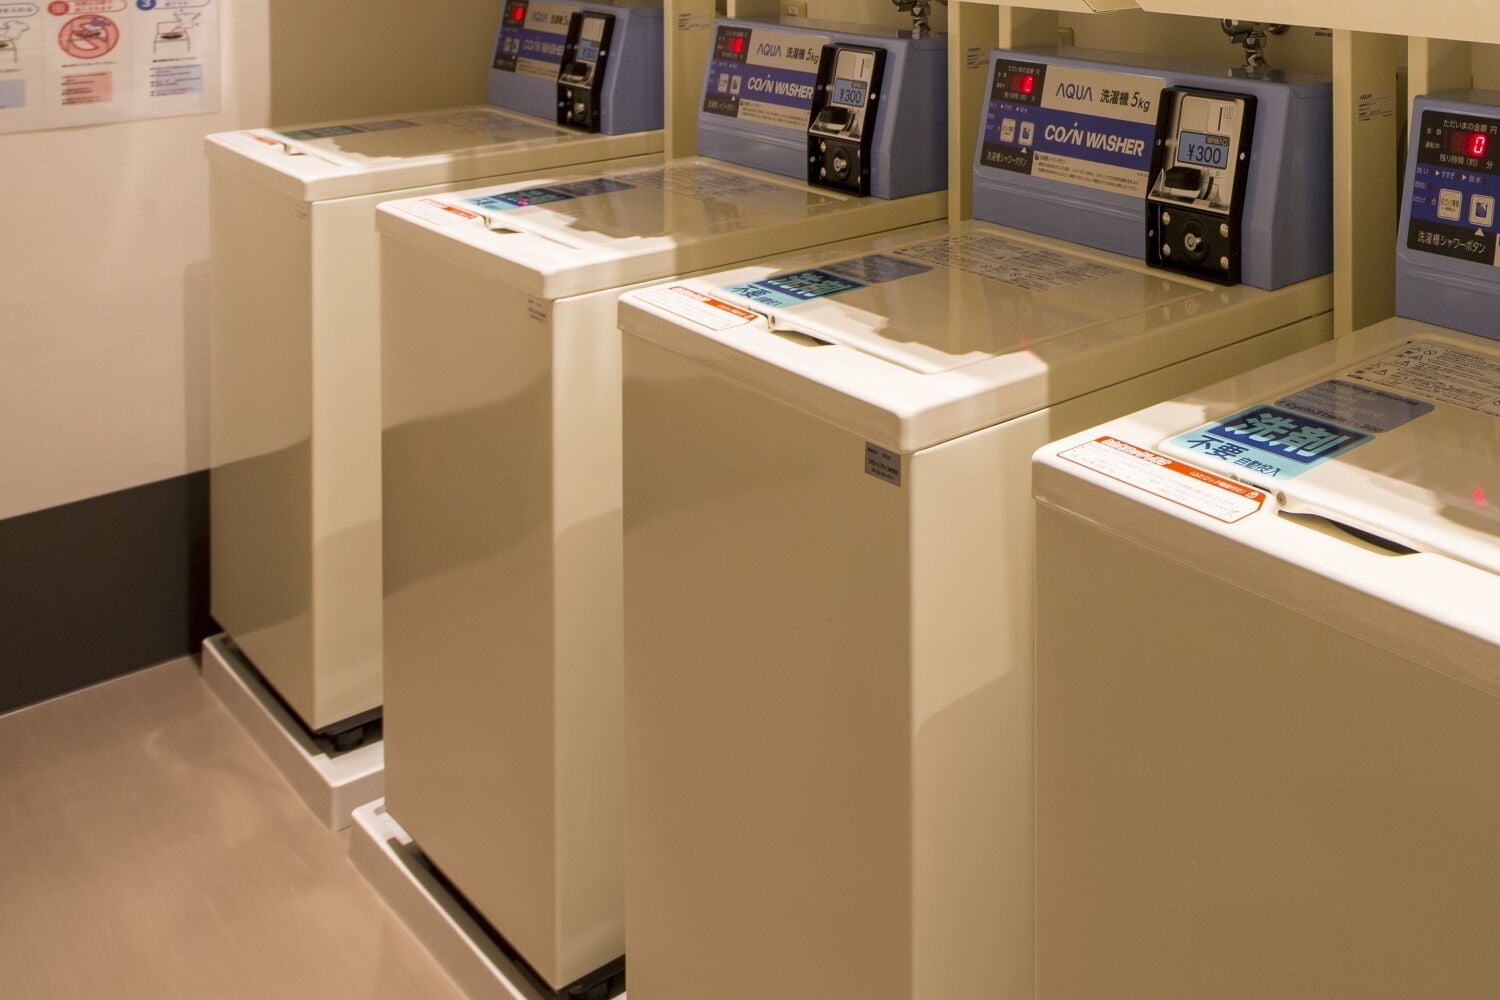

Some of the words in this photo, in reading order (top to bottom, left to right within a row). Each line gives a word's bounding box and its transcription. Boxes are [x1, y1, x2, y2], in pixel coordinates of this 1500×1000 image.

[756, 43, 782, 58] AQUA
[805, 48, 819, 65] 5kg
[775, 84, 814, 100] WASHER
[839, 87, 862, 104] ¥300
[1055, 82, 1093, 102] AQUA
[1100, 89, 1129, 106] 洗濯機
[1130, 91, 1151, 112] 5kg
[1044, 121, 1085, 146] COIN
[1086, 134, 1145, 156] WASHER
[1474, 136, 1485, 153] 0
[1187, 143, 1221, 164] ¥300
[1225, 412, 1352, 458] 洗剤
[1186, 434, 1250, 462] 不要
